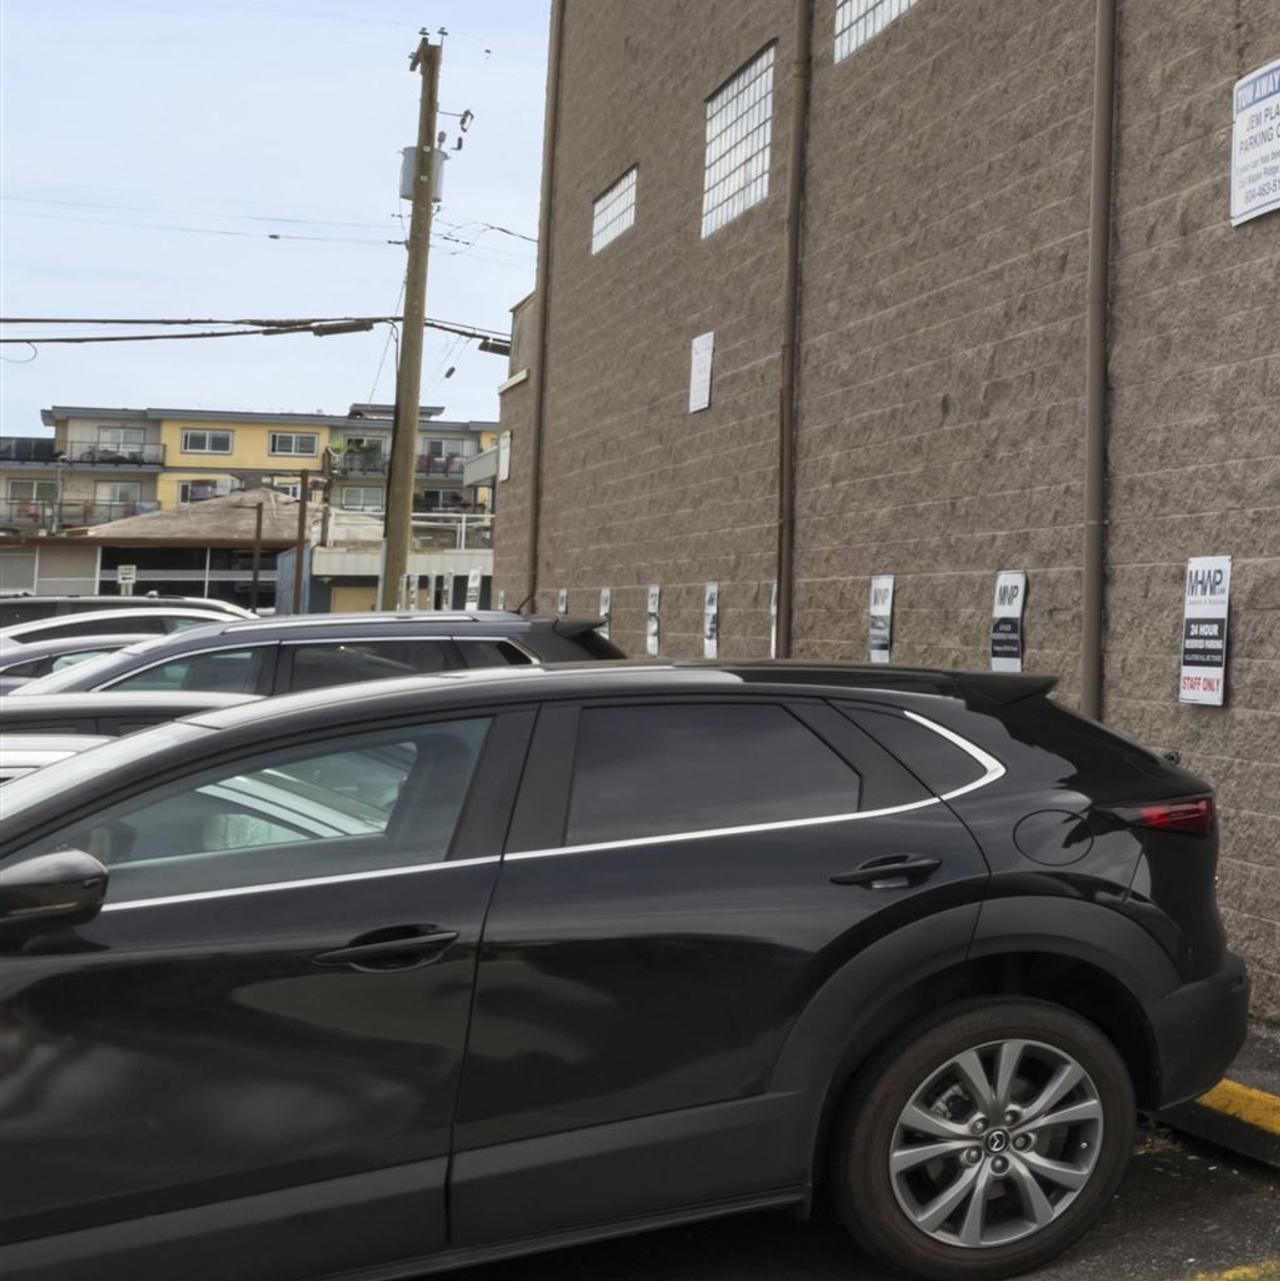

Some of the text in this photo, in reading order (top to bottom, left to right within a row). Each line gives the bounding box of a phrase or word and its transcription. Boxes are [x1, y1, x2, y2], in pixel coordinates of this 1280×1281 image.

[1255, 69, 1280, 99] AWAY
[1240, 126, 1273, 152] PARKING
[1189, 624, 1219, 636] 24 HOUR
[1182, 676, 1220, 692] STAFF ONLY
